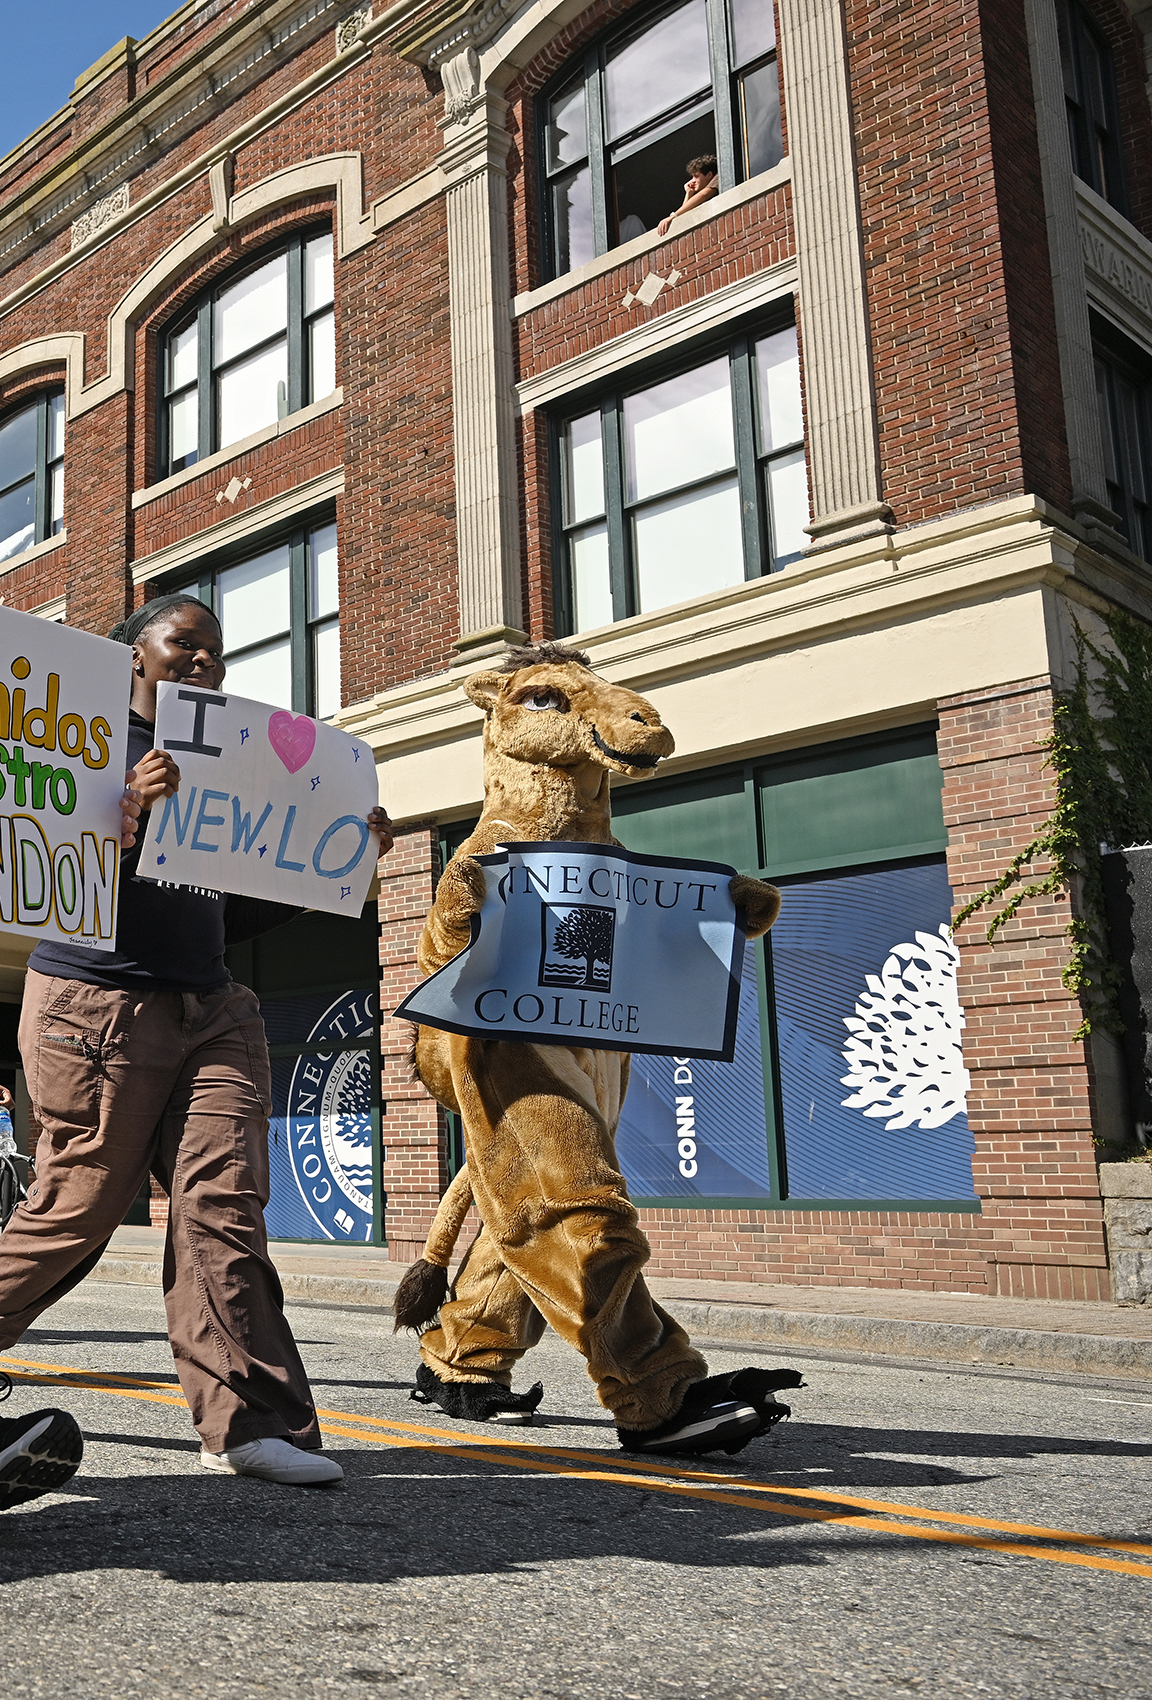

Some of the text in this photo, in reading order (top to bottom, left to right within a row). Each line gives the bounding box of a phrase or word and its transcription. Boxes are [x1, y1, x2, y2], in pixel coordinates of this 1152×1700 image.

[163, 689, 228, 758] I
[154, 786, 370, 879] NEW LO
[474, 989, 639, 1034] COLLEGE
[675, 1096, 698, 1179] CONN
